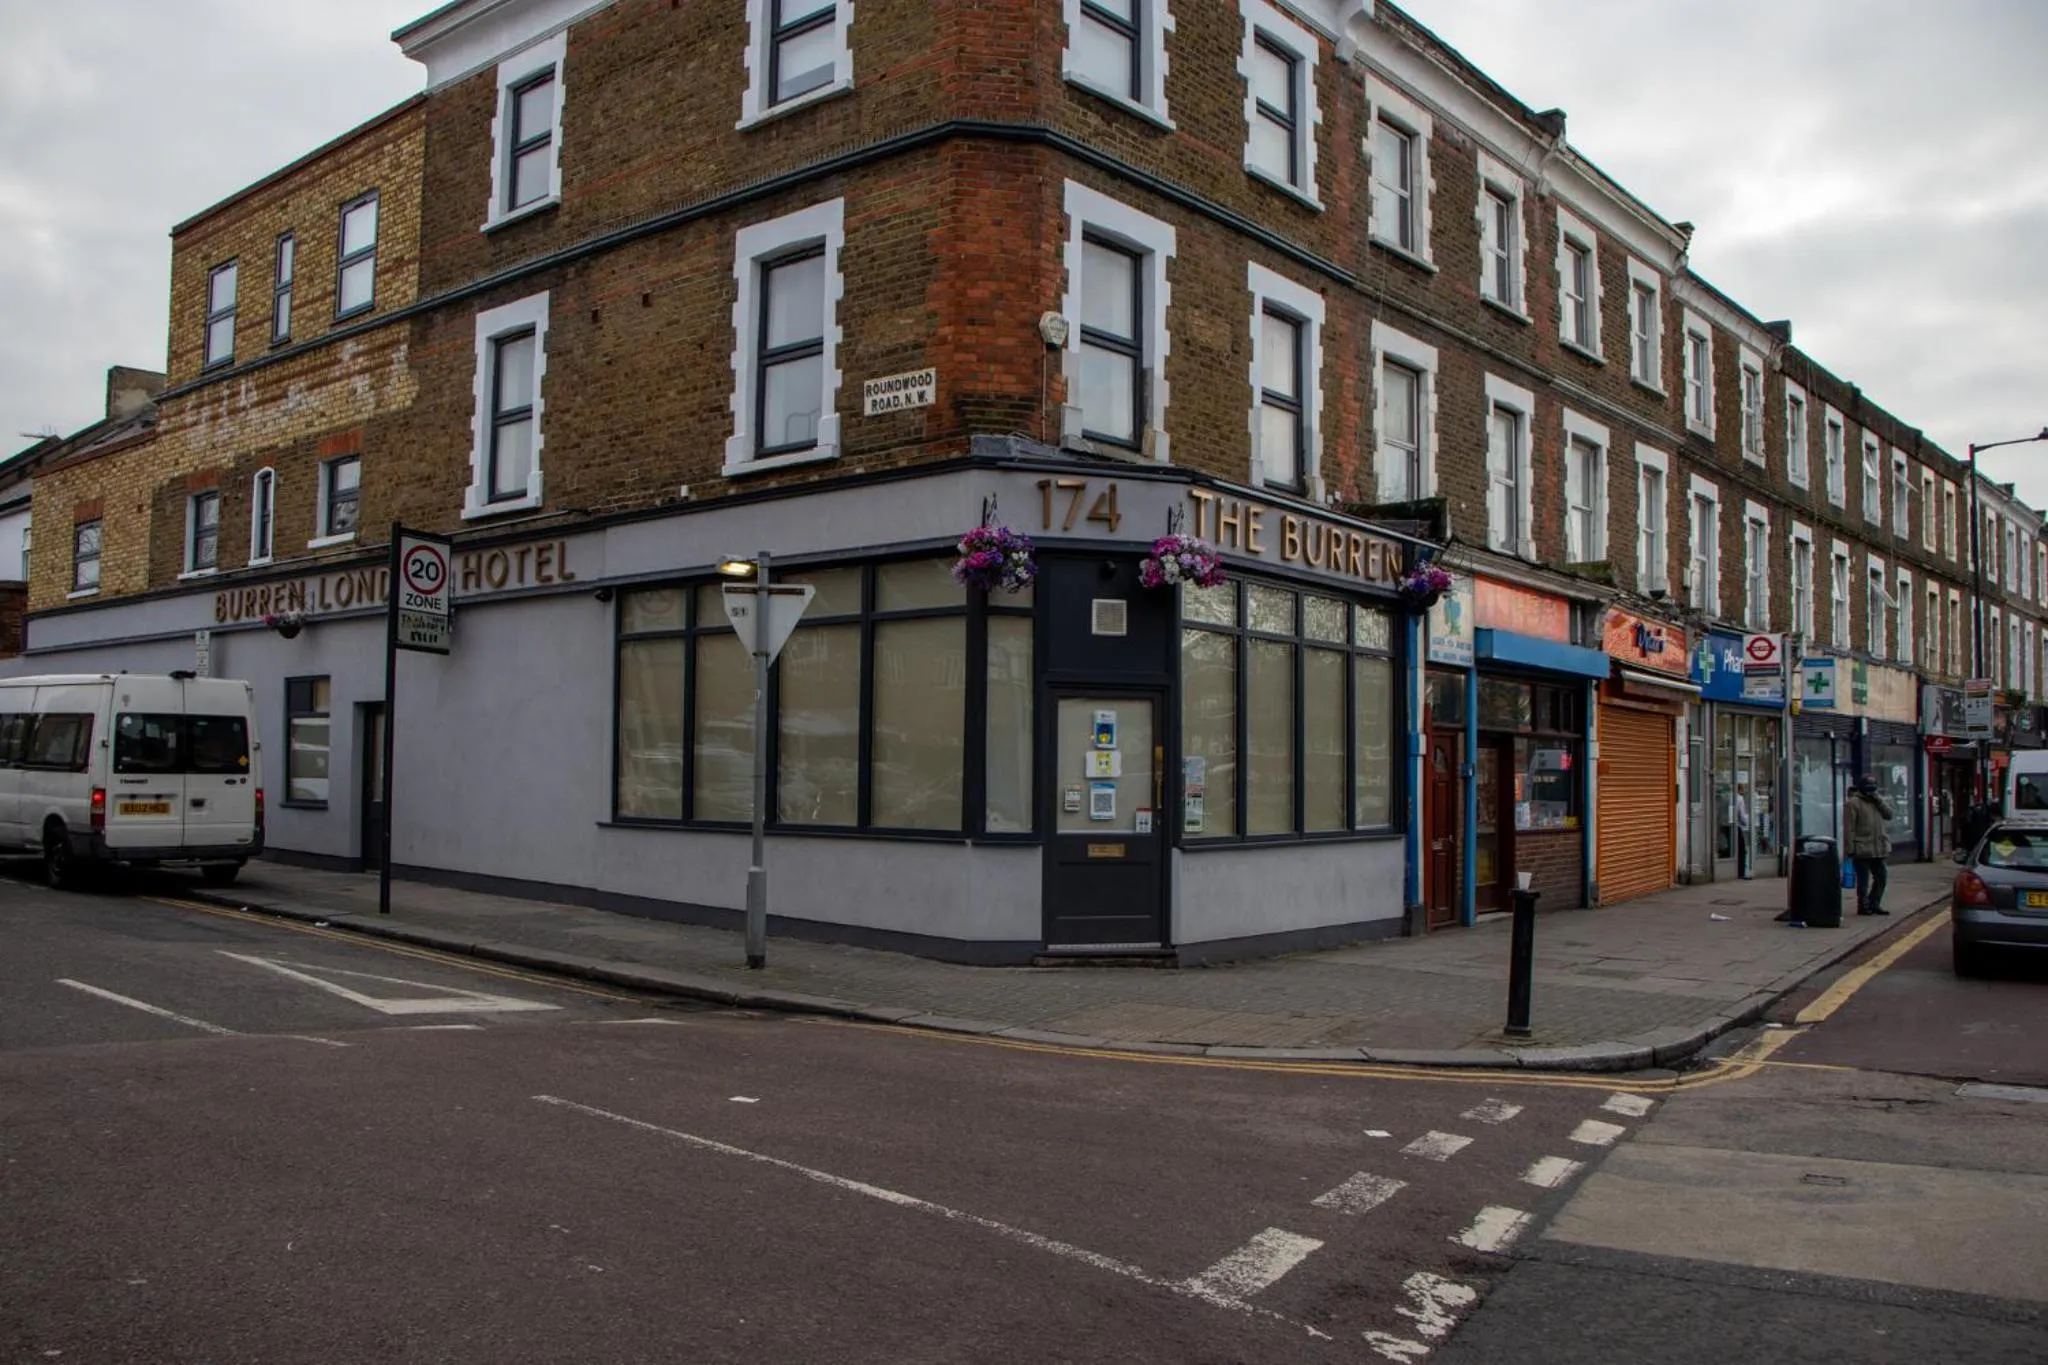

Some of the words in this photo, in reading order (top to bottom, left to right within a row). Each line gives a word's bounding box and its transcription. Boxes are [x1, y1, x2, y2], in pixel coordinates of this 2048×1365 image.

[865, 372, 932, 398] ROUNDWOOD
[1037, 479, 1123, 533] 174
[1188, 488, 1266, 554] THE
[1281, 514, 1403, 583] BURREN
[215, 579, 306, 623] BURREN
[318, 567, 391, 611] LOND
[462, 541, 576, 592] HOTEL
[411, 558, 440, 582] 20
[406, 593, 442, 610] ZONE
[1723, 647, 1744, 674] Phar
